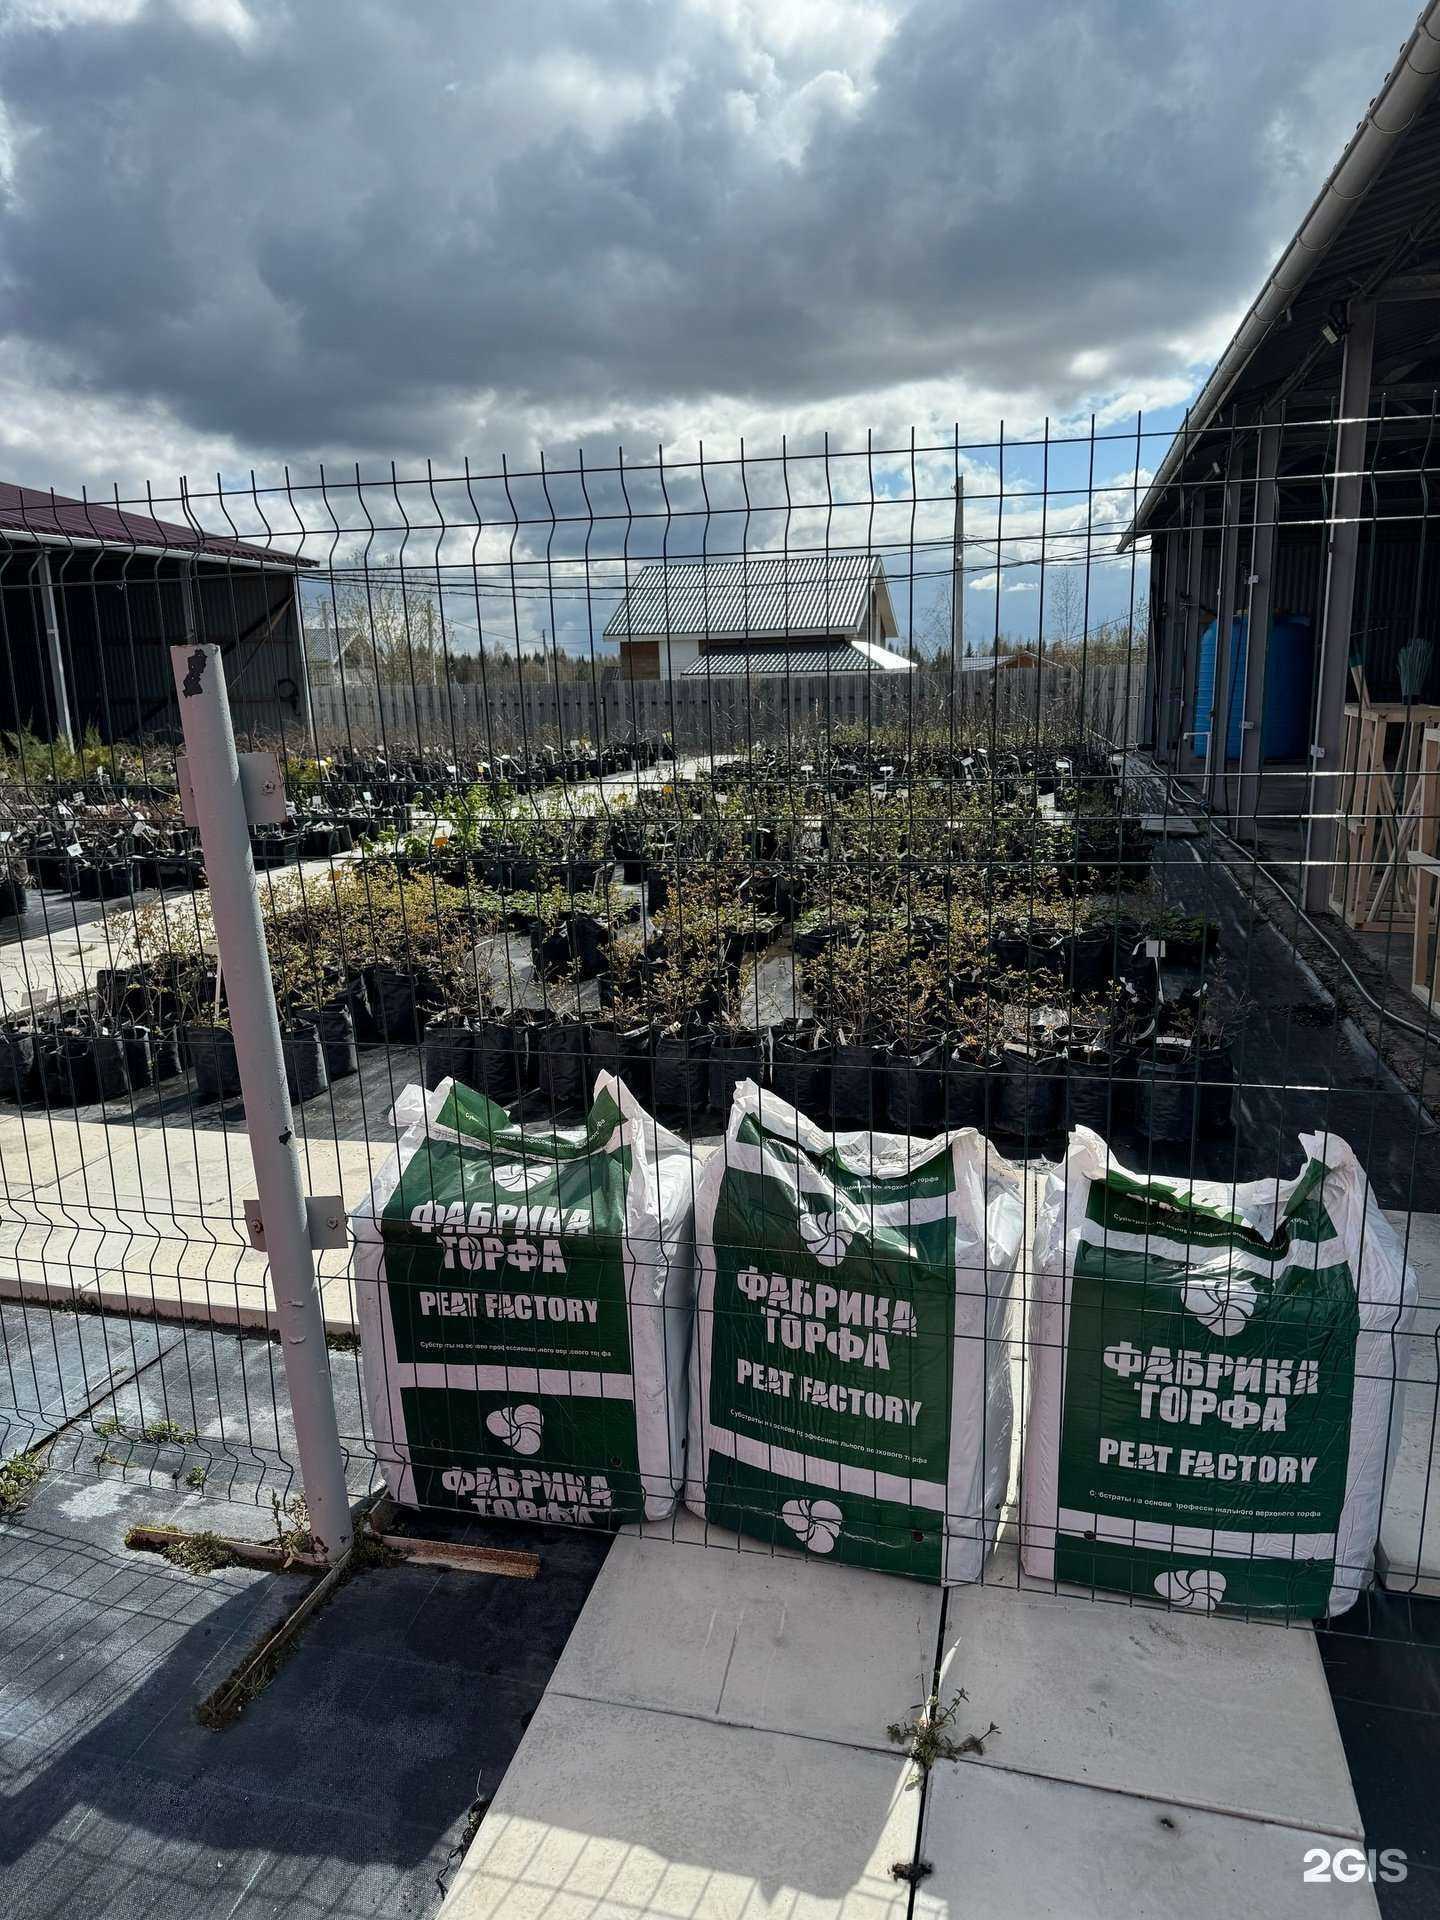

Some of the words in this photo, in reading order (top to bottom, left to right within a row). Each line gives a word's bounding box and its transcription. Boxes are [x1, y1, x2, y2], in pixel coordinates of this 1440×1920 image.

[410, 1200, 591, 1237] ФАБРИКА
[436, 1236, 567, 1274] ТОРФА
[419, 1291, 479, 1317] PEAT
[485, 1293, 598, 1323] FACTORY
[737, 1265, 918, 1338] ФАБРИКА
[760, 1305, 891, 1371] ТОРФА
[1103, 1341, 1319, 1395] ФАБРИКА
[737, 1358, 794, 1398] PEAT
[800, 1376, 922, 1427] FACTORY
[1134, 1382, 1287, 1432] ТОРФА
[1099, 1437, 1173, 1473] PEAT
[1179, 1448, 1318, 1483] FACTORY
[442, 1466, 613, 1508] ФАБРИКА
